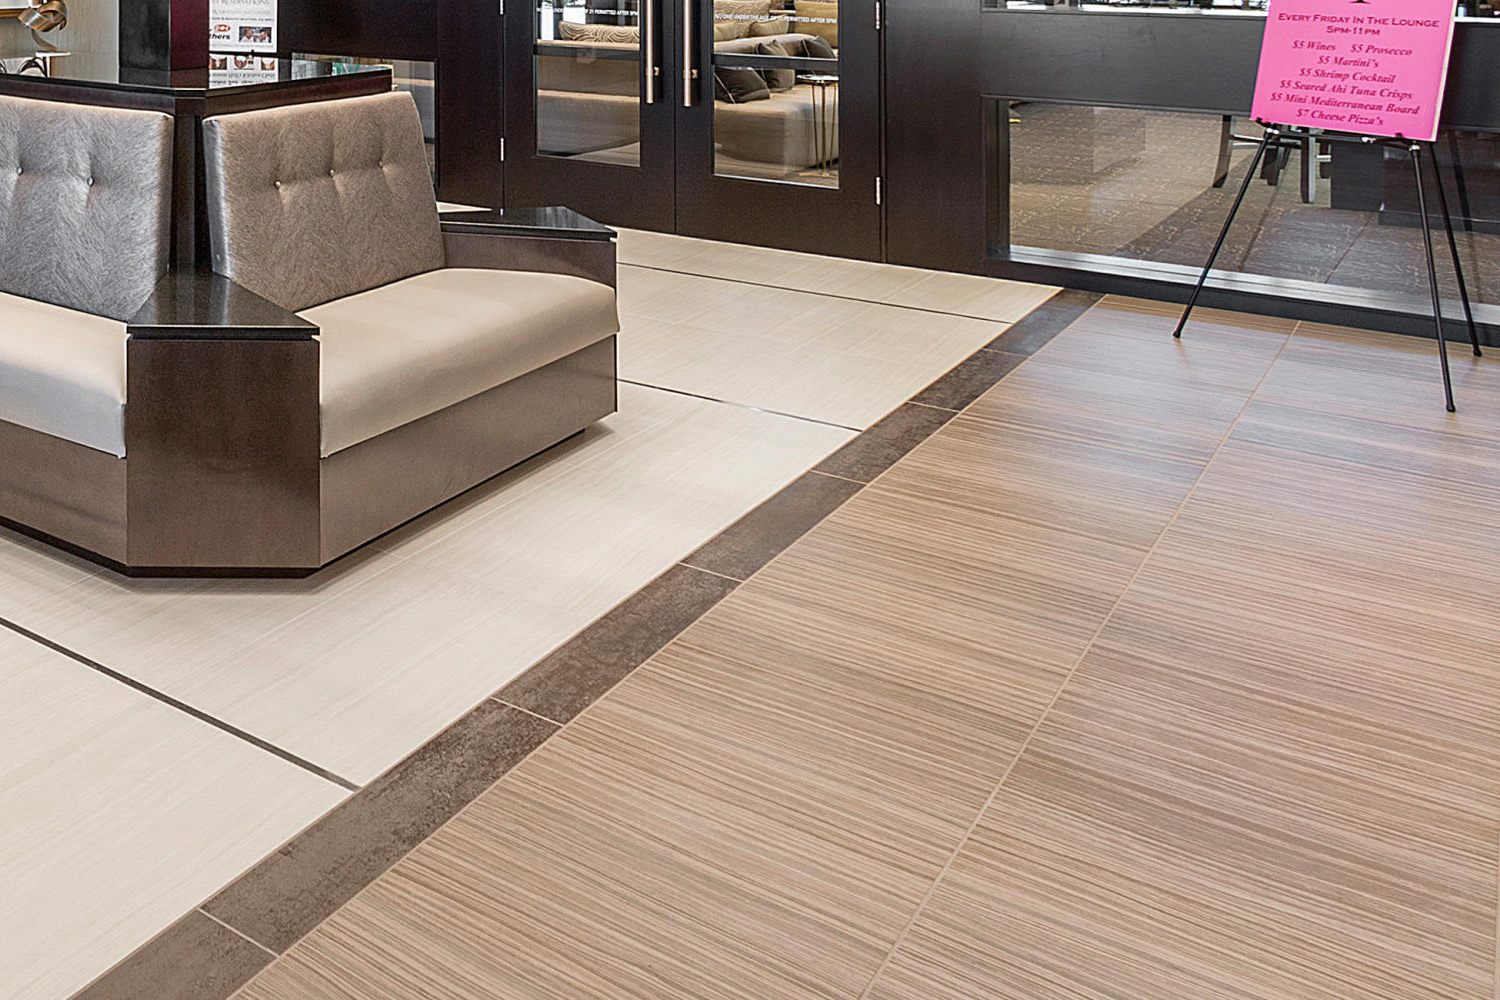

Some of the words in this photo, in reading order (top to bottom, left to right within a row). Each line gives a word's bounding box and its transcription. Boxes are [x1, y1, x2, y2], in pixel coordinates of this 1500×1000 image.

[1278, 12, 1312, 22] EVERY
[1312, 14, 1351, 24] FRIDAY
[1366, 17, 1390, 26] THE
[1391, 18, 1441, 28] LOUNGE
[1292, 40, 1305, 50] $5
[1306, 41, 1337, 52] Wines
[1350, 43, 1363, 53] $5
[1365, 45, 1413, 57] Prosecco
[1317, 55, 1330, 65] $5
[1332, 56, 1380, 69] Martini's
[1299, 67, 1312, 77] $5
[1313, 68, 1350, 83] Shrimp
[1352, 72, 1397, 84] Cocktail
[1279, 79, 1292, 89] $5
[1293, 81, 1327, 93] Seared
[1328, 84, 1347, 94] Ahi
[1349, 86, 1377, 97] Tuna
[1379, 88, 1413, 101] Crisps
[1270, 92, 1283, 102] $5
[1284, 93, 1307, 104] Mini
[1309, 95, 1384, 112] Mediterranean
[1386, 103, 1421, 115] Board
[1297, 108, 1309, 118] $7
[1311, 109, 1346, 122] Cheese
[1348, 113, 1384, 126] Pizza's
